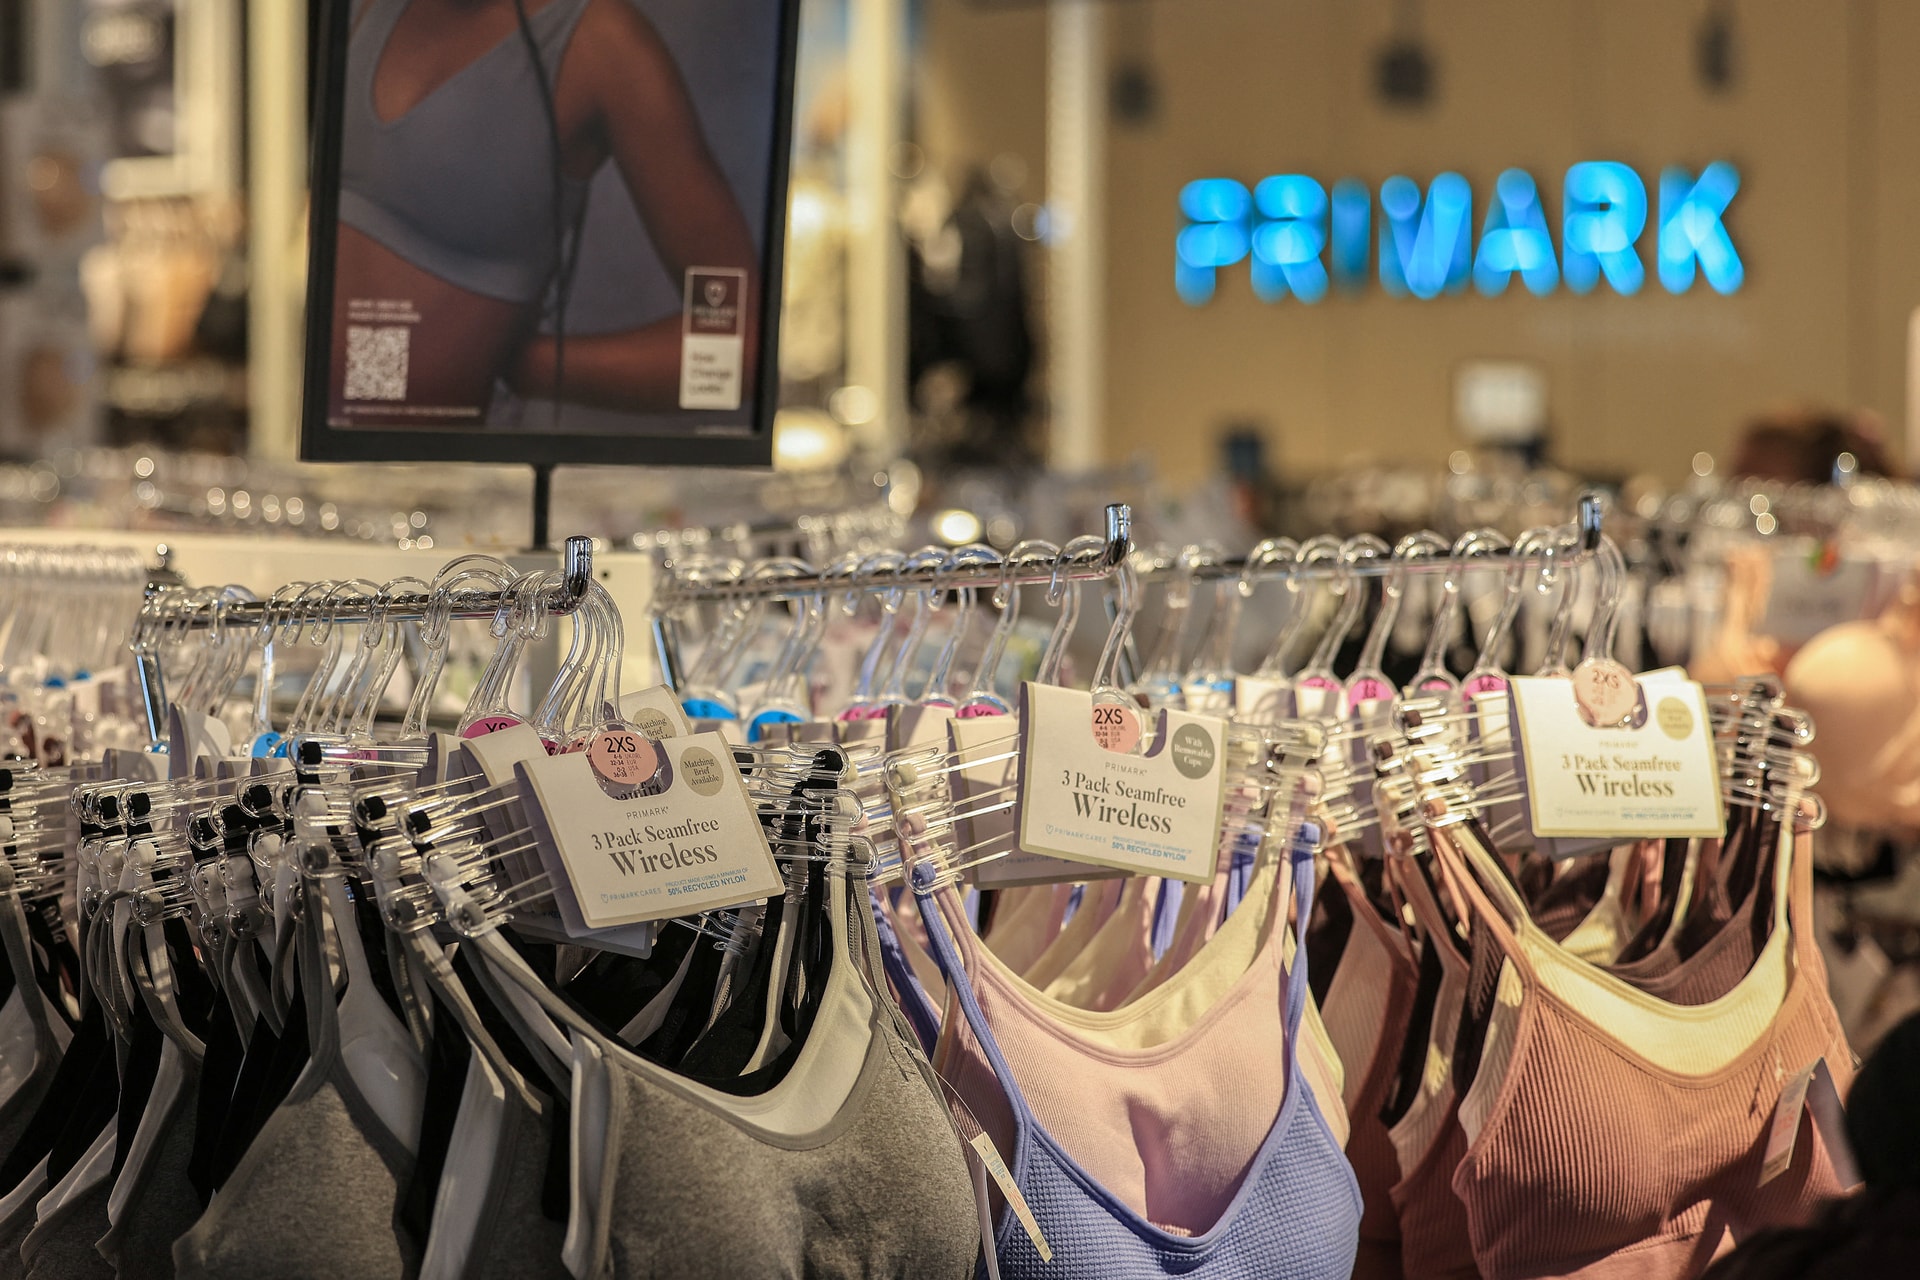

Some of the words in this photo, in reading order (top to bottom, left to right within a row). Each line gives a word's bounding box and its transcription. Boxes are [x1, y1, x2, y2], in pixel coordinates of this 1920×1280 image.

[1175, 160, 1745, 305] PRIMARK
[1592, 668, 1620, 689] 2XS
[1094, 708, 1123, 725] 2XS
[646, 726, 663, 737] Brief
[604, 736, 636, 753] 2XS
[1184, 735, 1203, 748] With
[683, 758, 715, 769] Matching
[1105, 762, 1144, 777] PRIMARK
[1183, 755, 1203, 768] Cups
[1561, 754, 1570, 770] 3
[1574, 754, 1608, 771] Pack
[1612, 755, 1682, 772] Seamfree
[691, 774, 719, 785] Available
[693, 766, 710, 776] Brief
[1061, 770, 1070, 786] 3
[1075, 772, 1111, 794] Pack
[1115, 780, 1186, 808] Seamfree
[1575, 774, 1675, 798] Wireless
[626, 807, 668, 820] PRIMARK
[1072, 792, 1172, 834] Wireless
[591, 834, 602, 850] 3
[604, 827, 643, 848] Pack
[645, 818, 720, 842] Seamfree
[609, 842, 718, 876] Wireless
[1126, 844, 1162, 857] RECYCLED
[1163, 851, 1186, 862] NYLON
[667, 887, 683, 896] 50%
[682, 879, 720, 894] RECYCLED
[721, 874, 746, 887] NYLON
